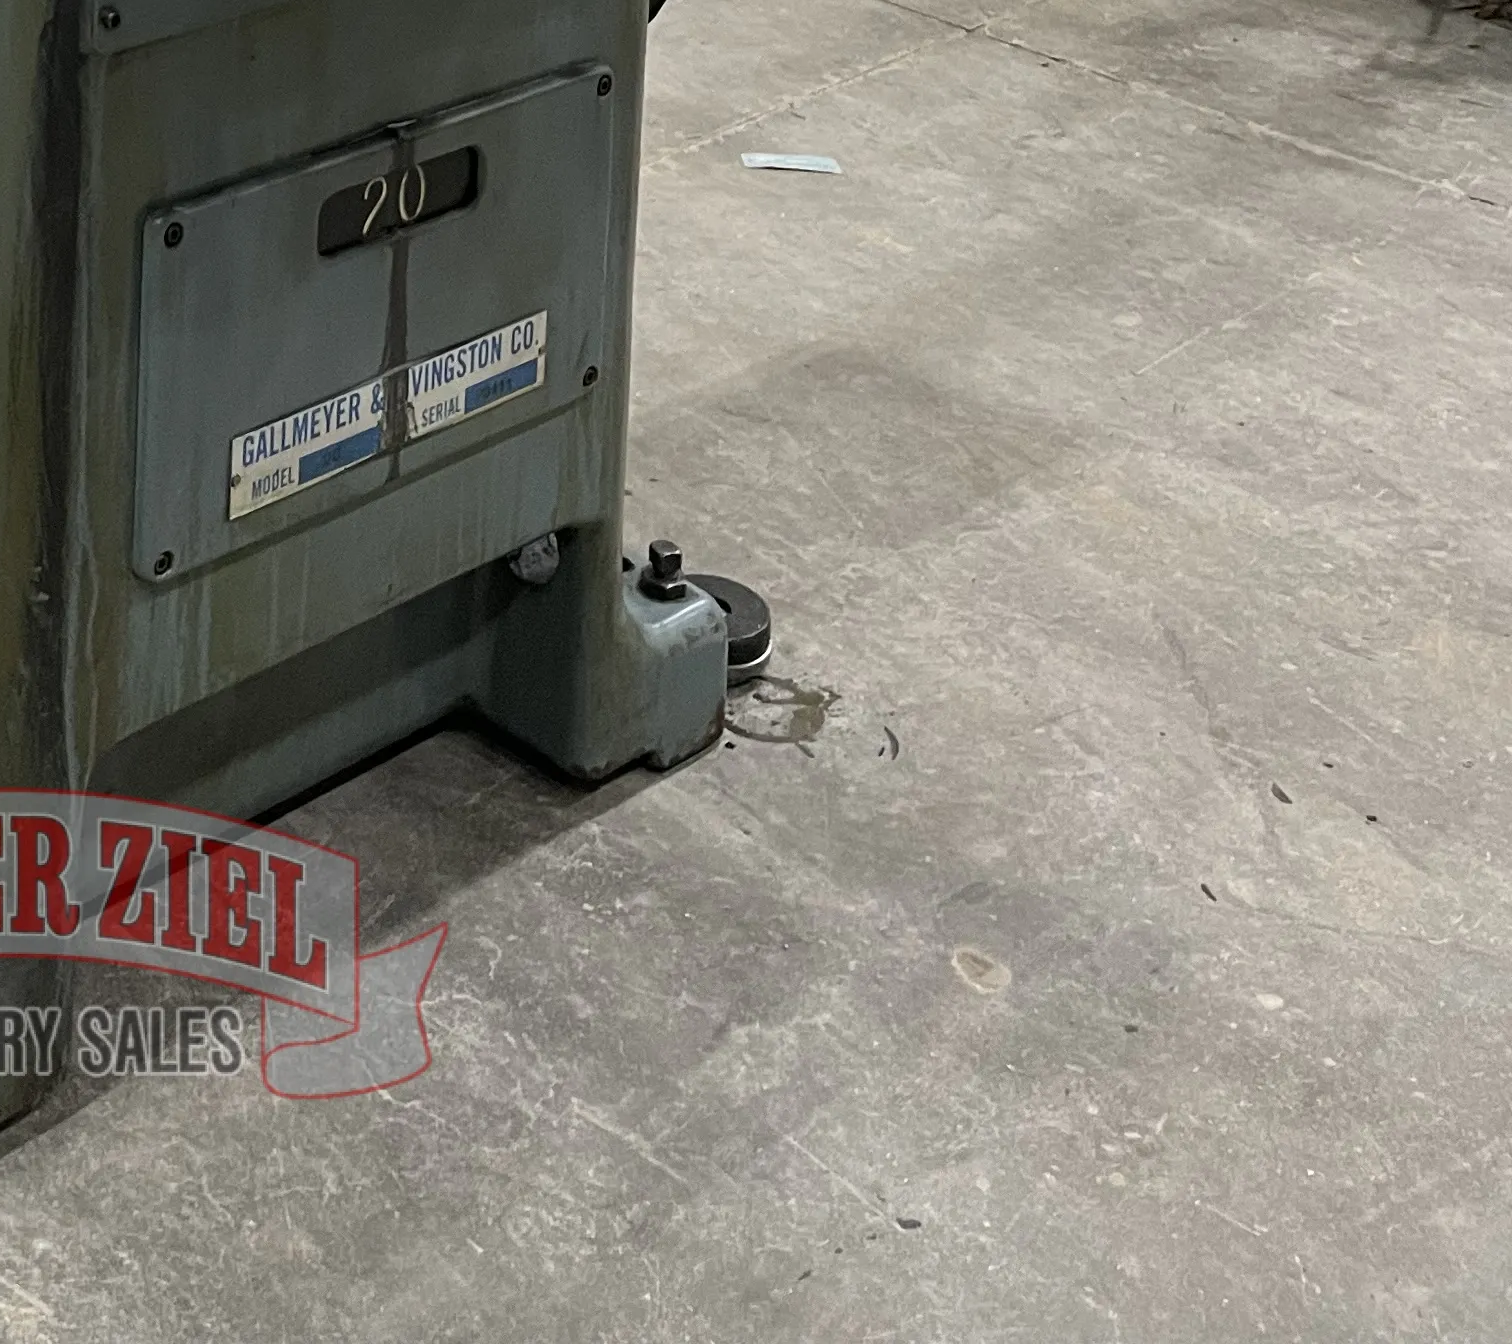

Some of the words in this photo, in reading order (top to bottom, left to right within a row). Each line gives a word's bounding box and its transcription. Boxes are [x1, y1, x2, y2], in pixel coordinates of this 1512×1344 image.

[242, 392, 361, 468] GALLMEYER
[410, 332, 503, 397] VINGSTON
[511, 320, 539, 355] CO.
[251, 466, 295, 501] MODEL
[421, 395, 462, 428] SERIAL
